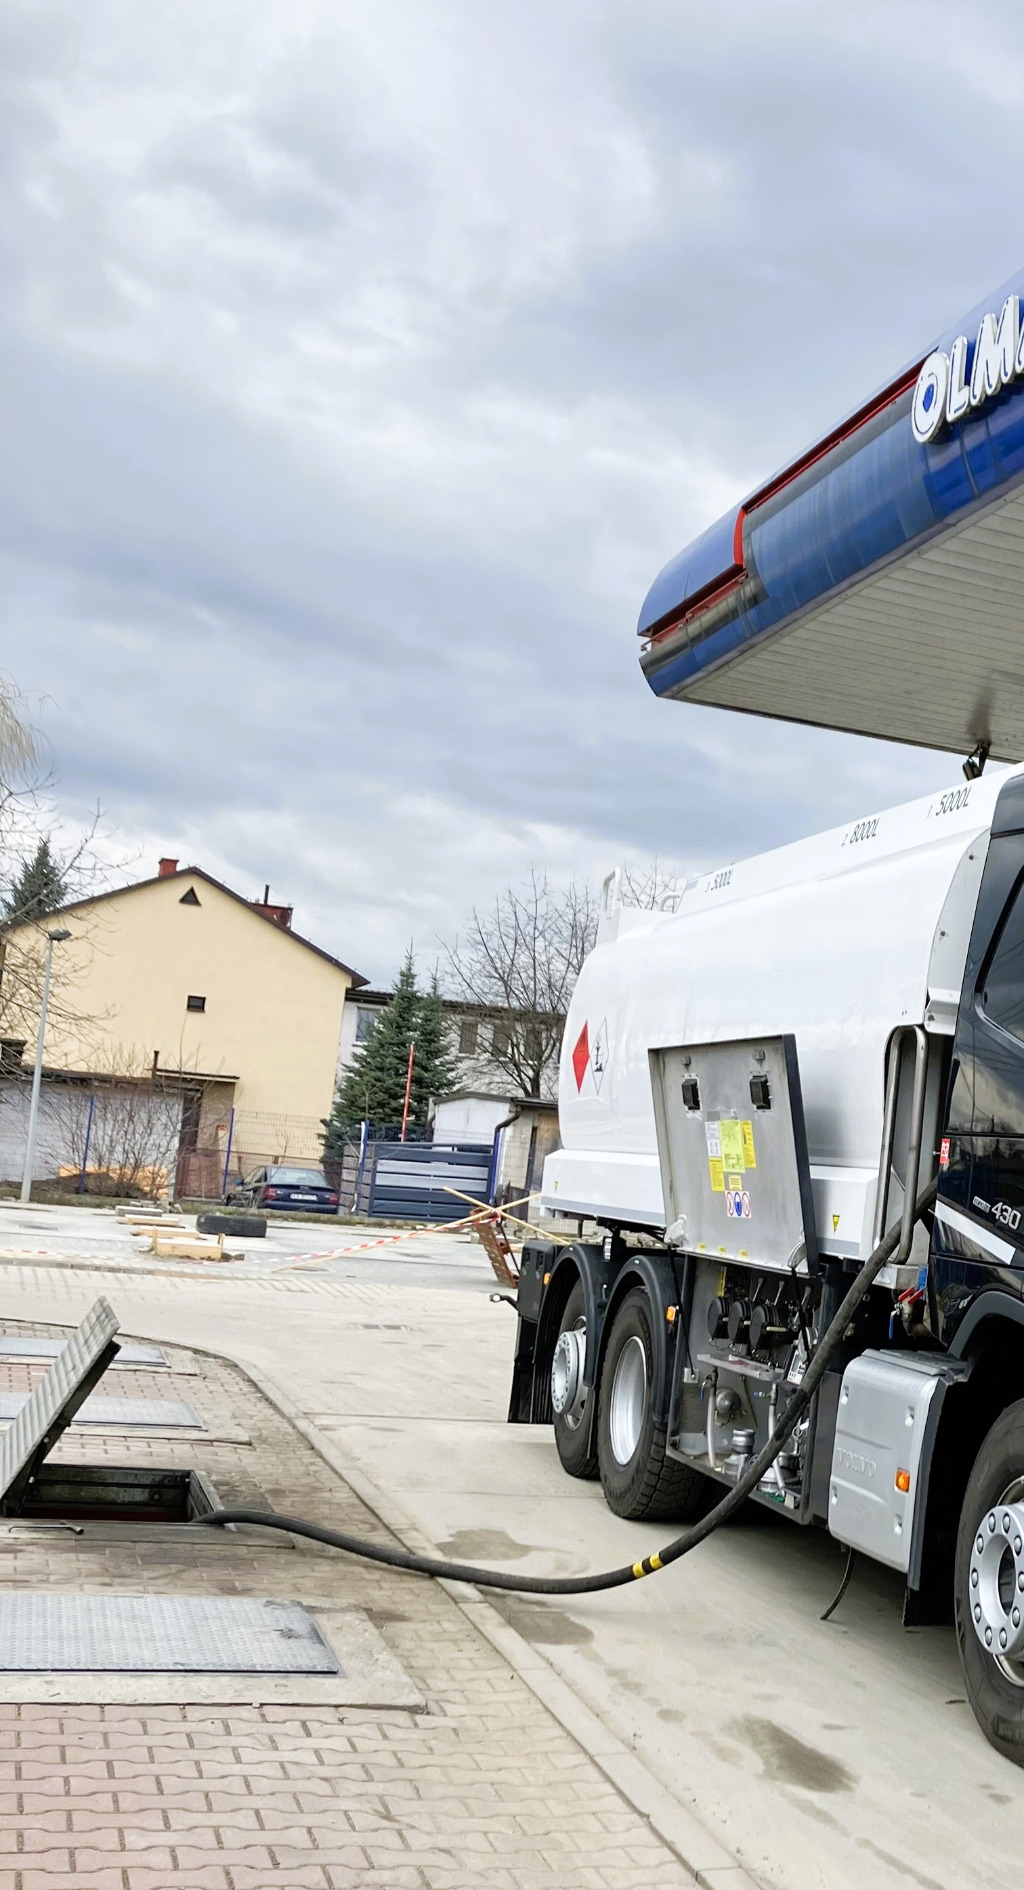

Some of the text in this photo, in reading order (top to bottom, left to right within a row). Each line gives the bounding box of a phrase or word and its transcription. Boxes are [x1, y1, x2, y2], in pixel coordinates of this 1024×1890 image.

[935, 786, 972, 816] 5000L
[850, 818, 880, 844] 8000L
[991, 1202, 1022, 1230] 430
[836, 1447, 877, 1478] VOLVO
